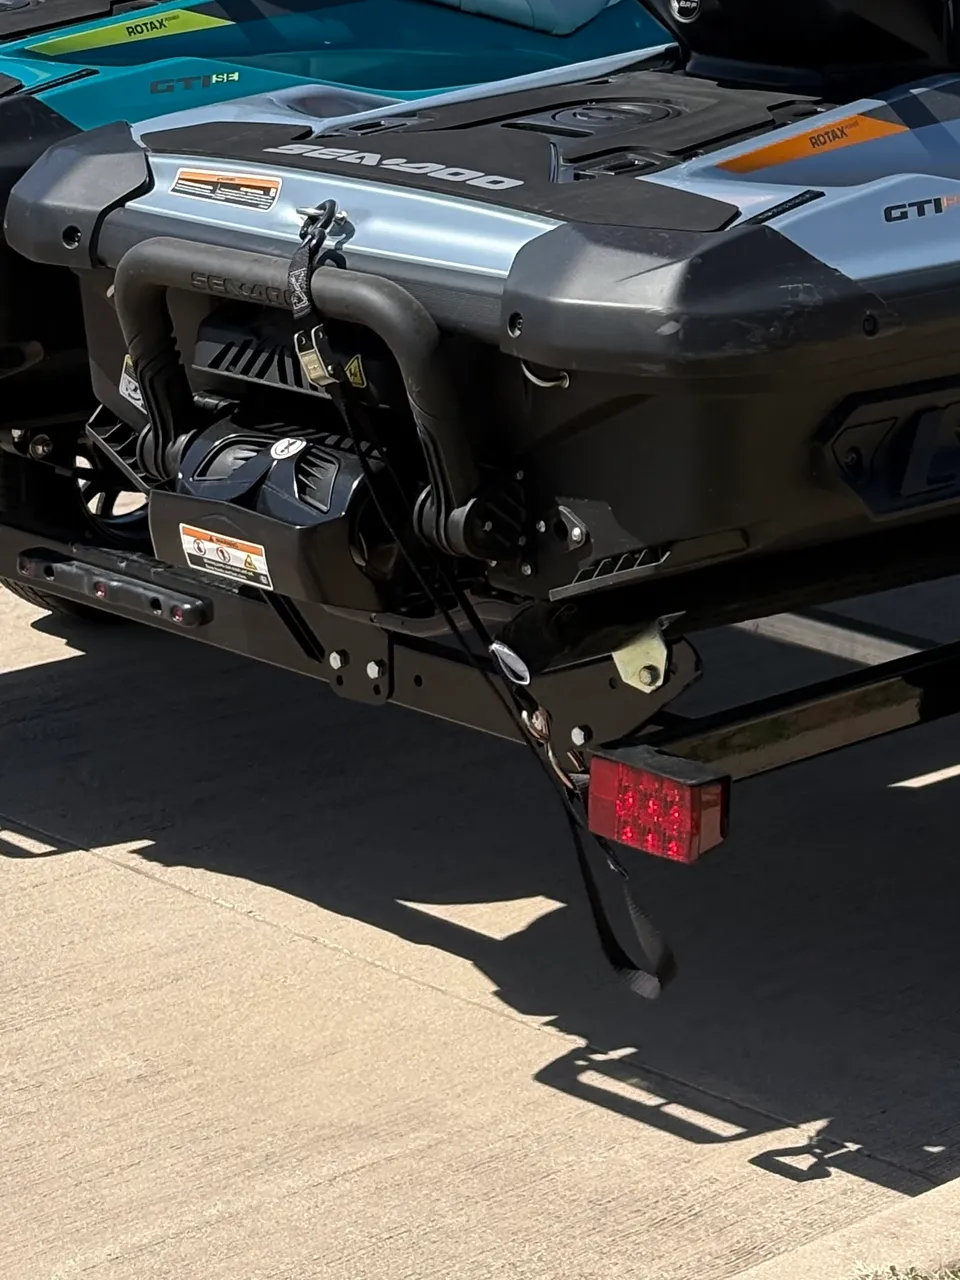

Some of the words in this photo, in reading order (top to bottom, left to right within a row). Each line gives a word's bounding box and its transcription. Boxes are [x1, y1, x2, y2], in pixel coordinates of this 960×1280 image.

[126, 18, 167, 37] ROTAX
[149, 74, 212, 94] GTI
[809, 126, 848, 148] ROTAX
[884, 197, 943, 223] GTI
